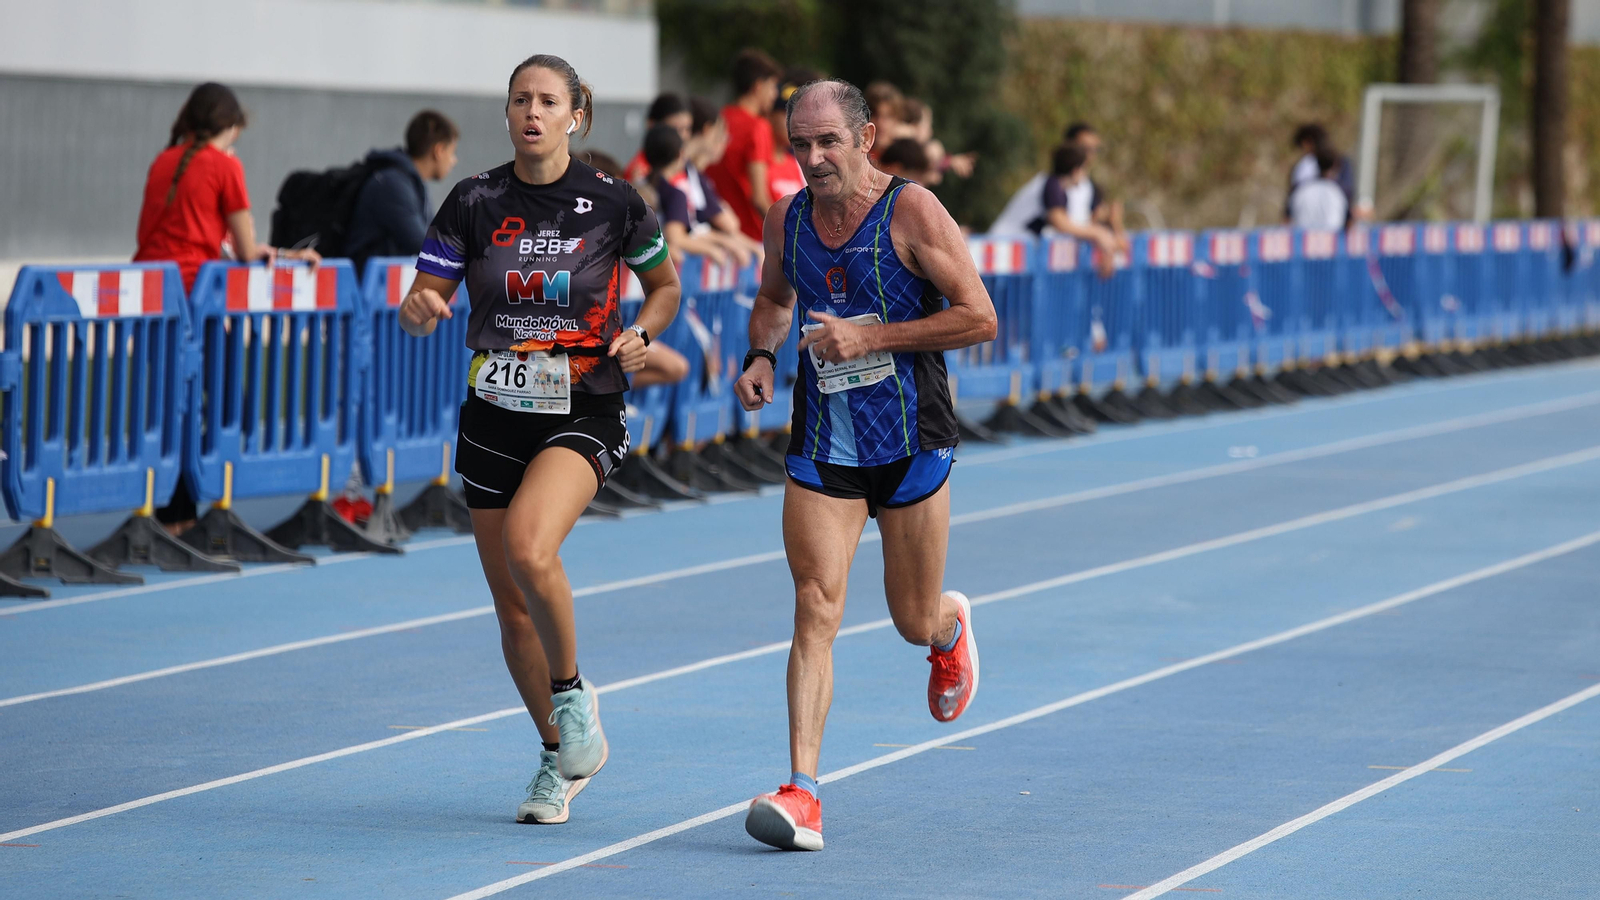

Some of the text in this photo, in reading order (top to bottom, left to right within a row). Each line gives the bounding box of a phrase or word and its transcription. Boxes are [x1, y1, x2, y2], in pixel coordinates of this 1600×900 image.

[519, 238, 560, 254] B2B
[506, 270, 570, 307] MM
[485, 360, 527, 388] 216
